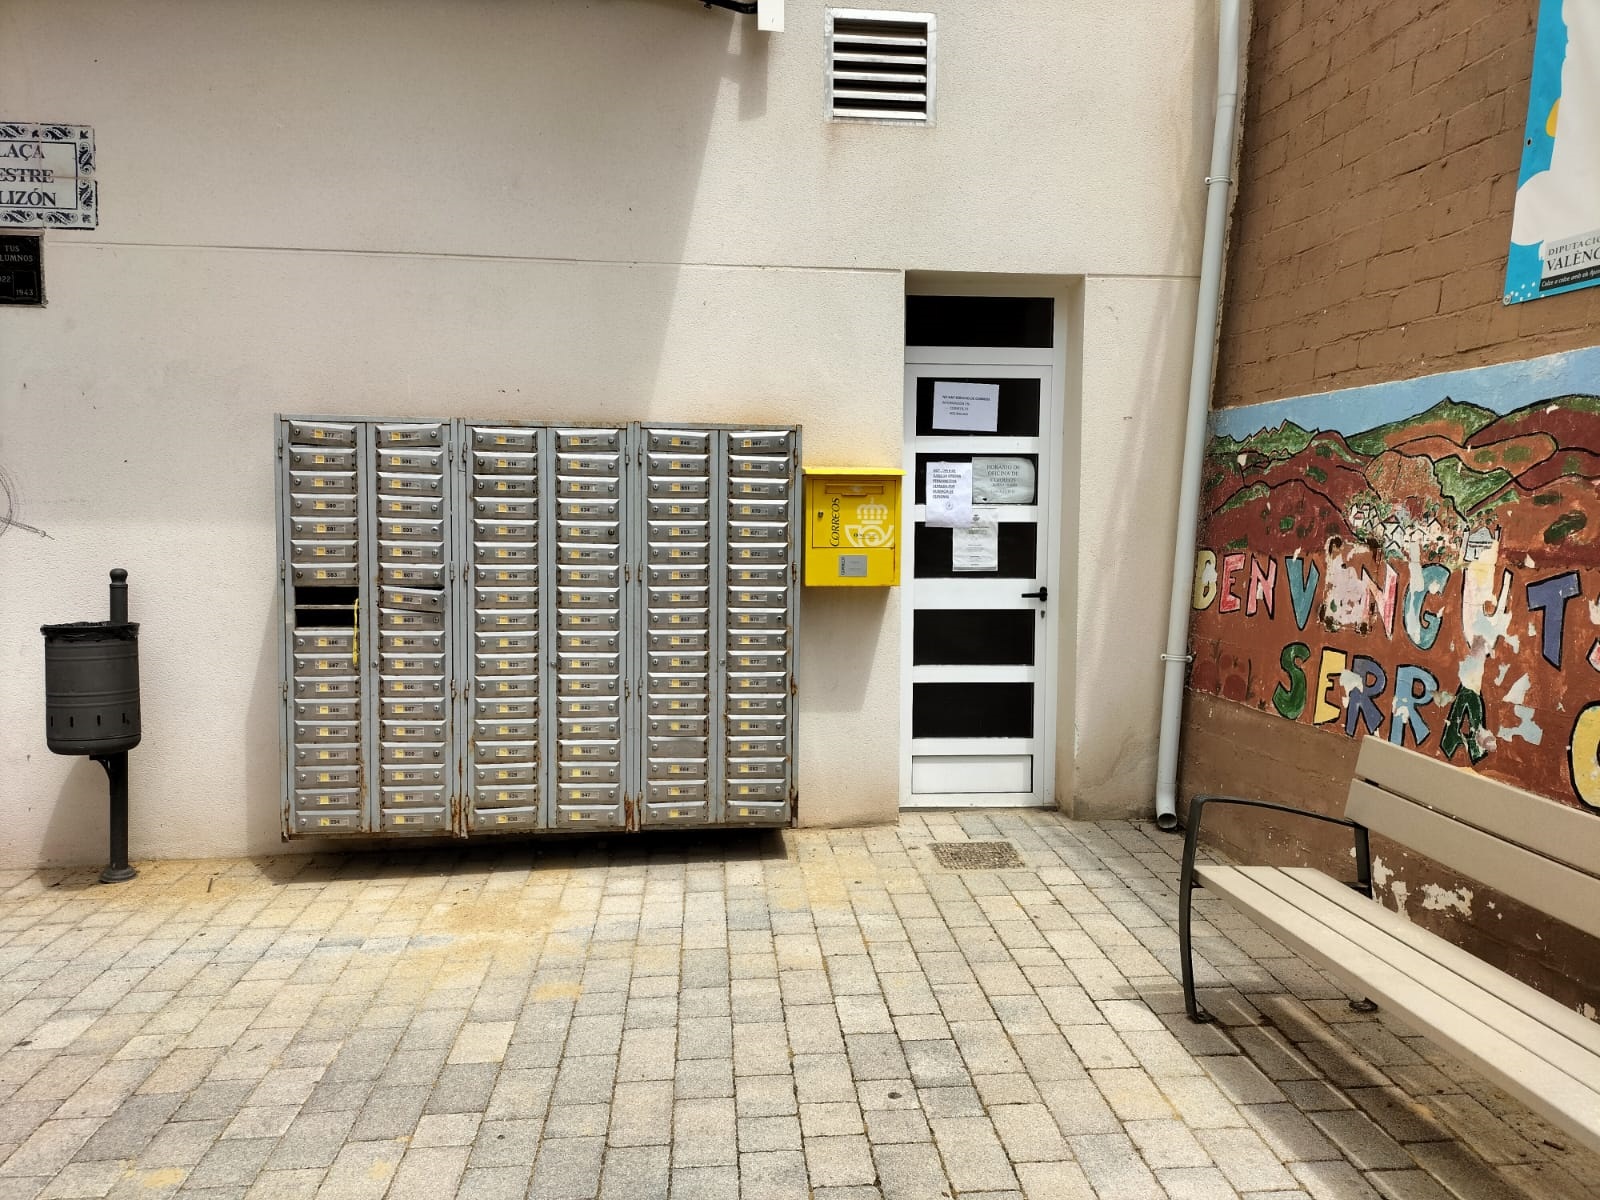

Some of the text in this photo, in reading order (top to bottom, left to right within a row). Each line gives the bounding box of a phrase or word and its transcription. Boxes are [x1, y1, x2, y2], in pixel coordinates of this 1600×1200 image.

[0, 187, 57, 206] LIZÓN
[830, 497, 840, 547] CORREOS
[1271, 642, 1489, 765] SERRA
